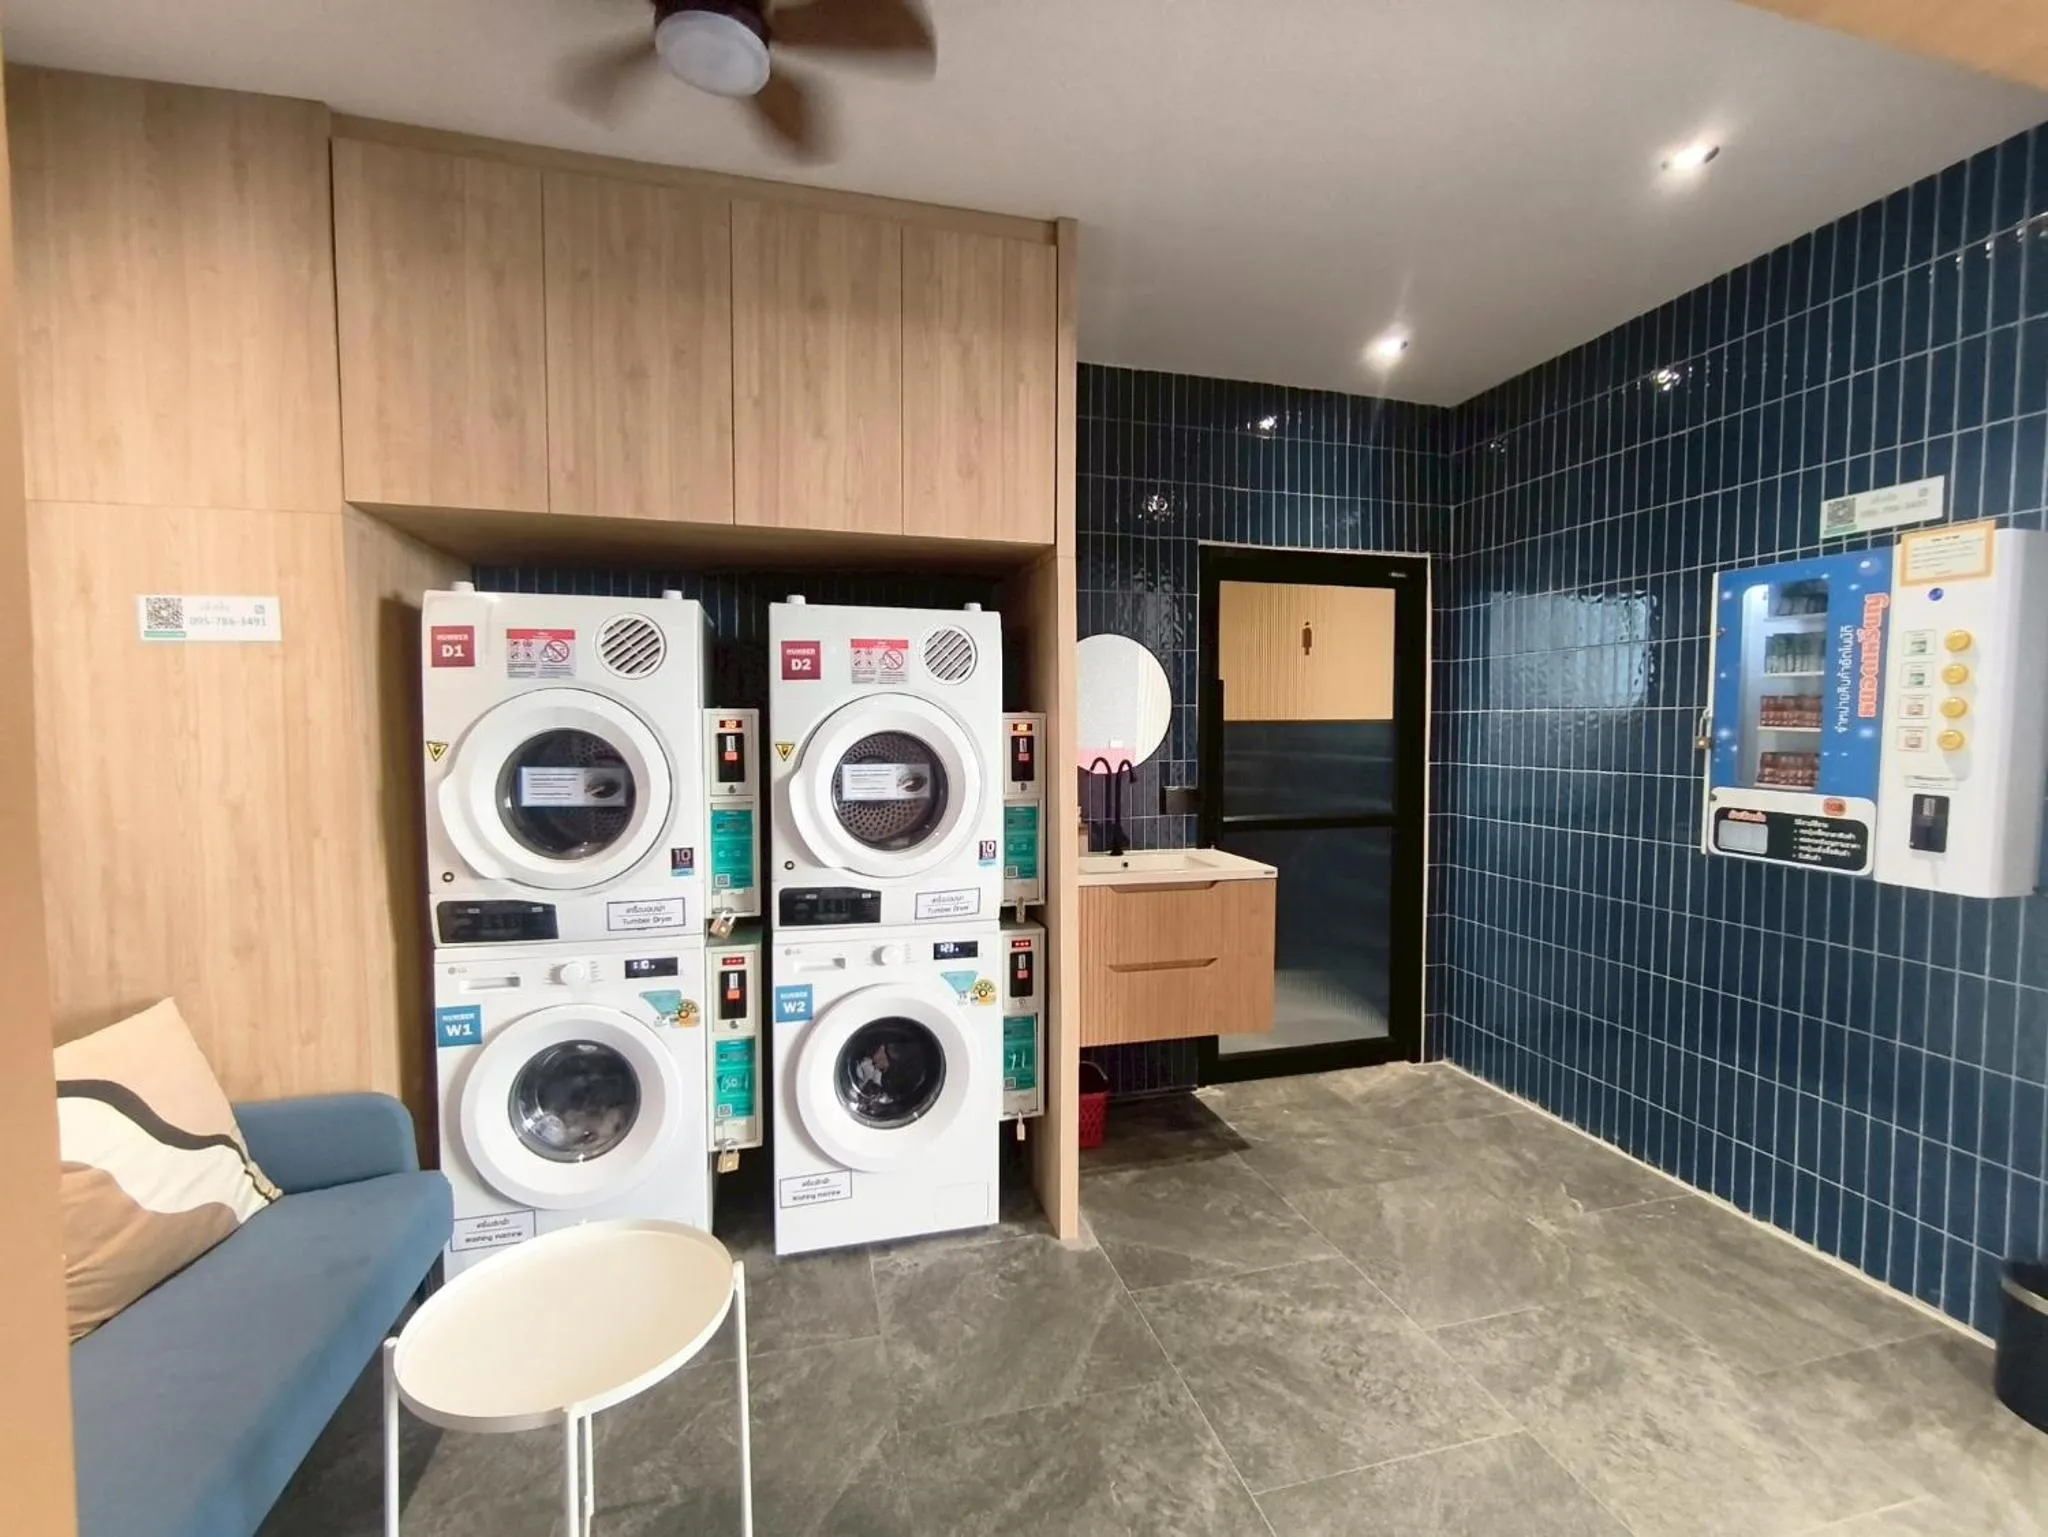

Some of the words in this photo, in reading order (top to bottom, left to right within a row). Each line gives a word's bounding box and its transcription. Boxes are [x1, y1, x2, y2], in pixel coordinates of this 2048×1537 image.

[441, 644, 465, 658] D1
[786, 648, 816, 656] NUMBER
[1857, 592, 1889, 717] หยอดเหรียญ
[791, 658, 812, 671] D2
[981, 841, 995, 852] 10
[675, 849, 691, 861] 10
[783, 1001, 806, 1014] W2
[445, 1023, 474, 1036] W1
